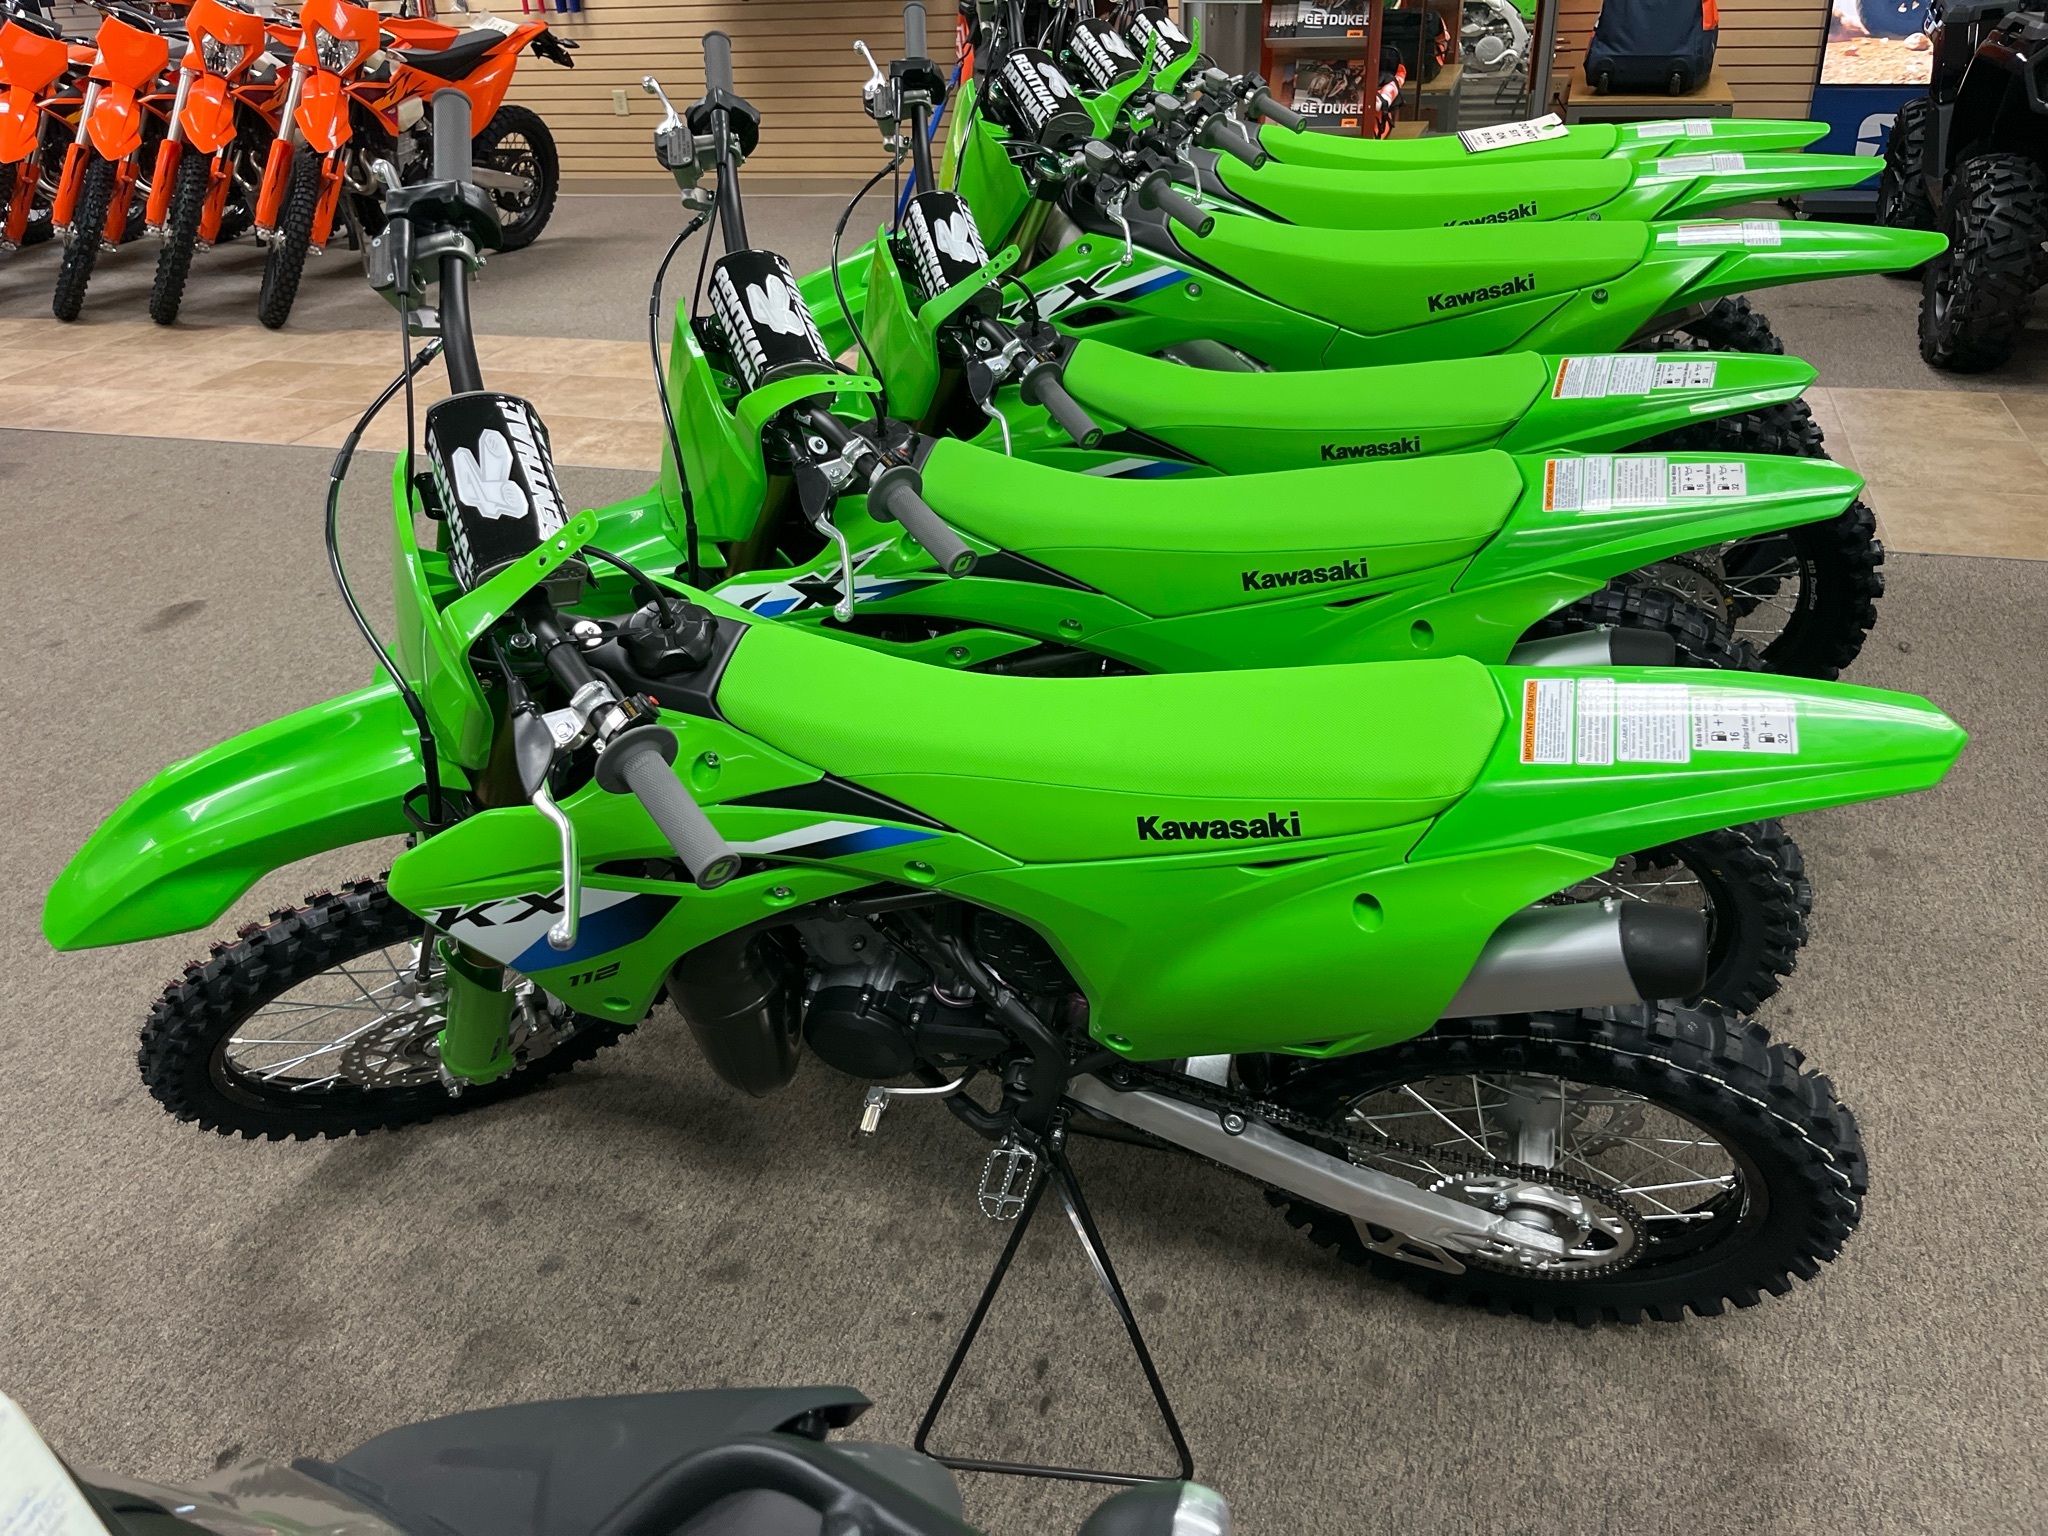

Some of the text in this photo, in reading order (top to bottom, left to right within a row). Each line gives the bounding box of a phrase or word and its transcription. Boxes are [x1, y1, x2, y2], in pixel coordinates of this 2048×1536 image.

[1002, 62, 1050, 129] RENTHAL
[1012, 54, 1060, 114] RENTHAL
[1427, 273, 1535, 313] Kawasaki
[715, 266, 768, 376] RENTHAL
[1321, 435, 1420, 461] Kawasaki
[1242, 557, 1369, 592] Kawasaki
[1525, 682, 1536, 760] IMPORTANT INFORMATION
[1729, 732, 1740, 742] 16
[1742, 728, 1750, 750] Standard
[1777, 733, 1788, 744] 32
[1136, 810, 1301, 841] Kawasaki
[569, 961, 621, 987] 112
